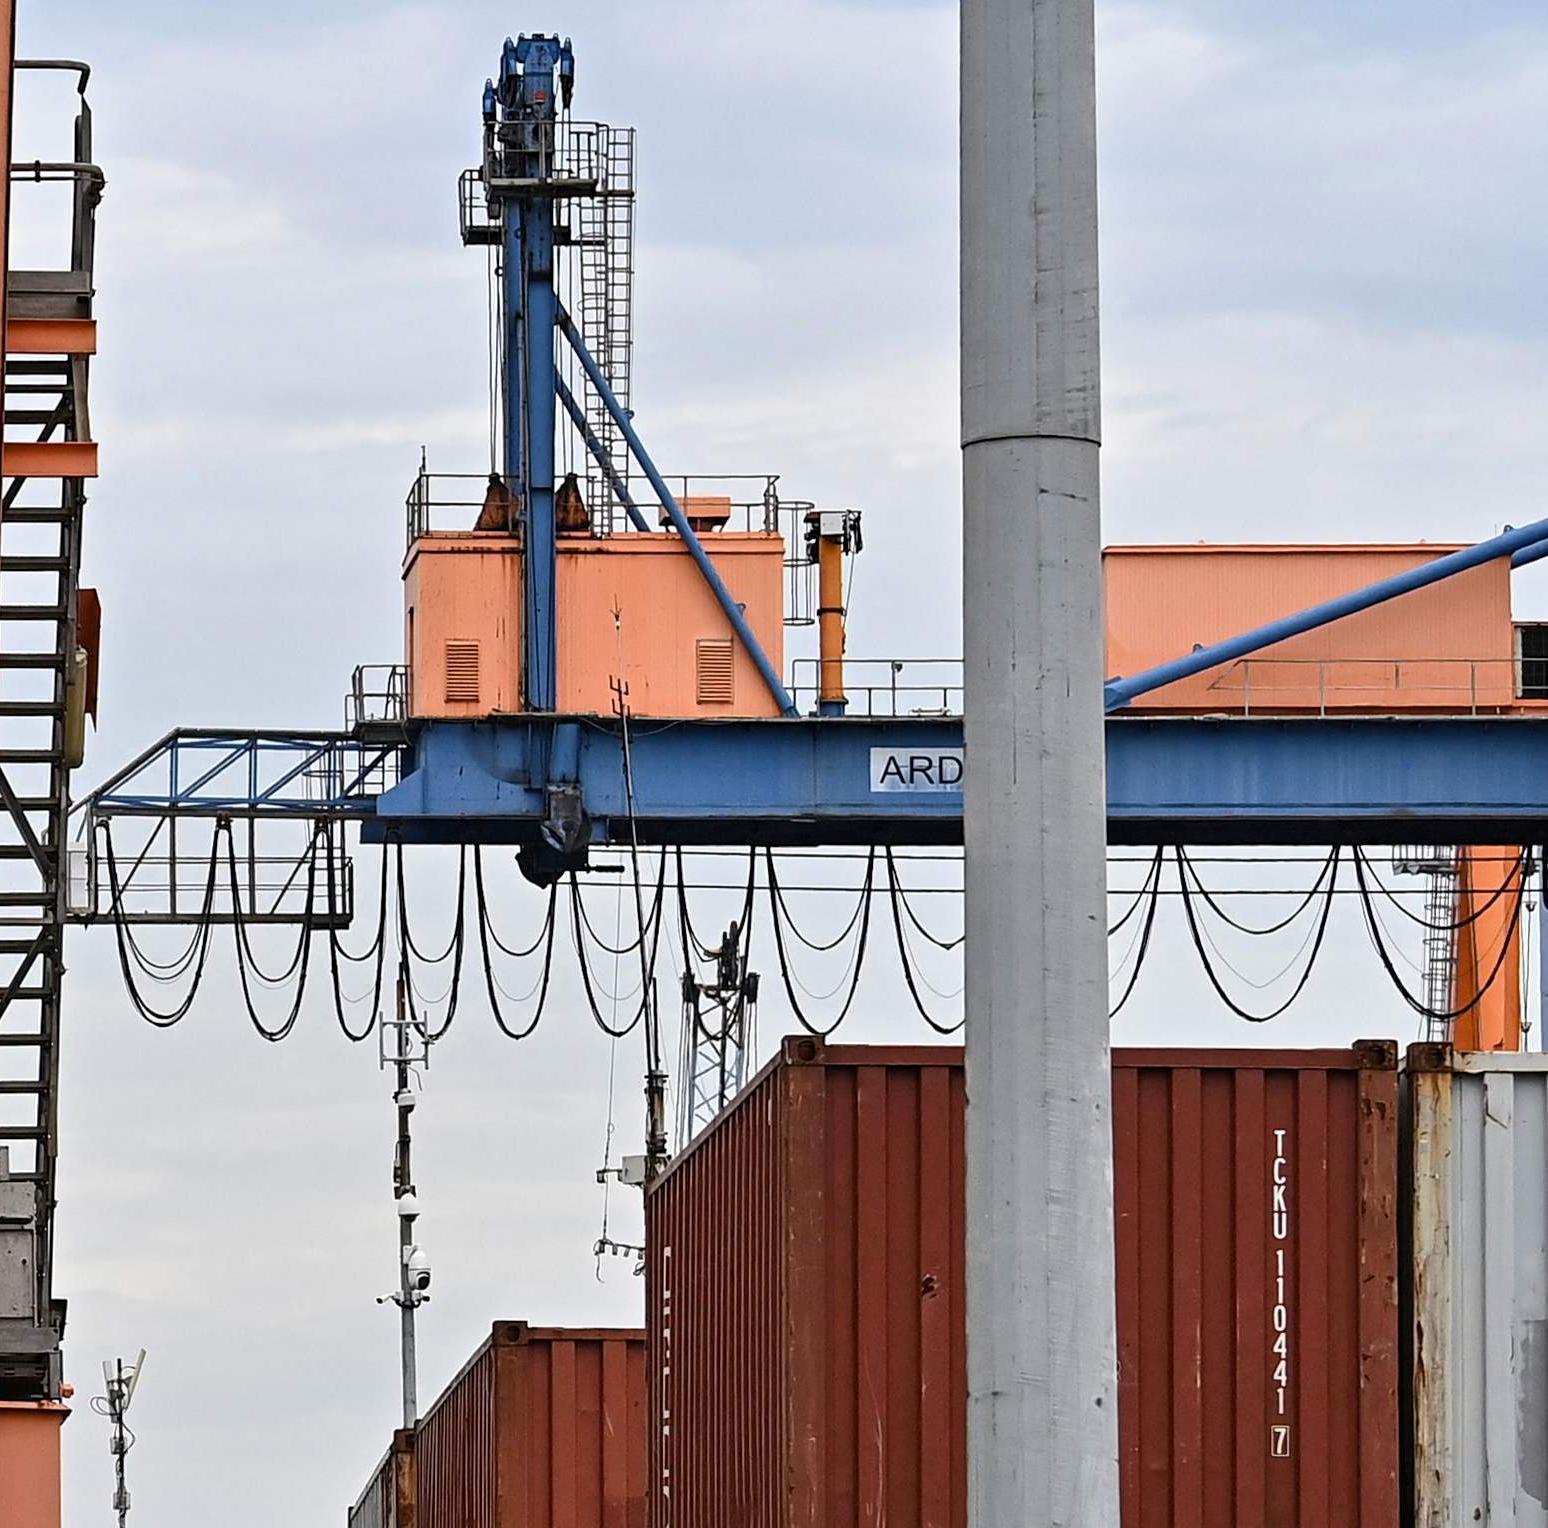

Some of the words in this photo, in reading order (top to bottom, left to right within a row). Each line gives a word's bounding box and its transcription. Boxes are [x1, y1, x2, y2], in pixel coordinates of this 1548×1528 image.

[880, 755, 963, 785] ARD
[1273, 1129, 1287, 1240] TCKU
[1273, 1249, 1287, 1415] 110441
